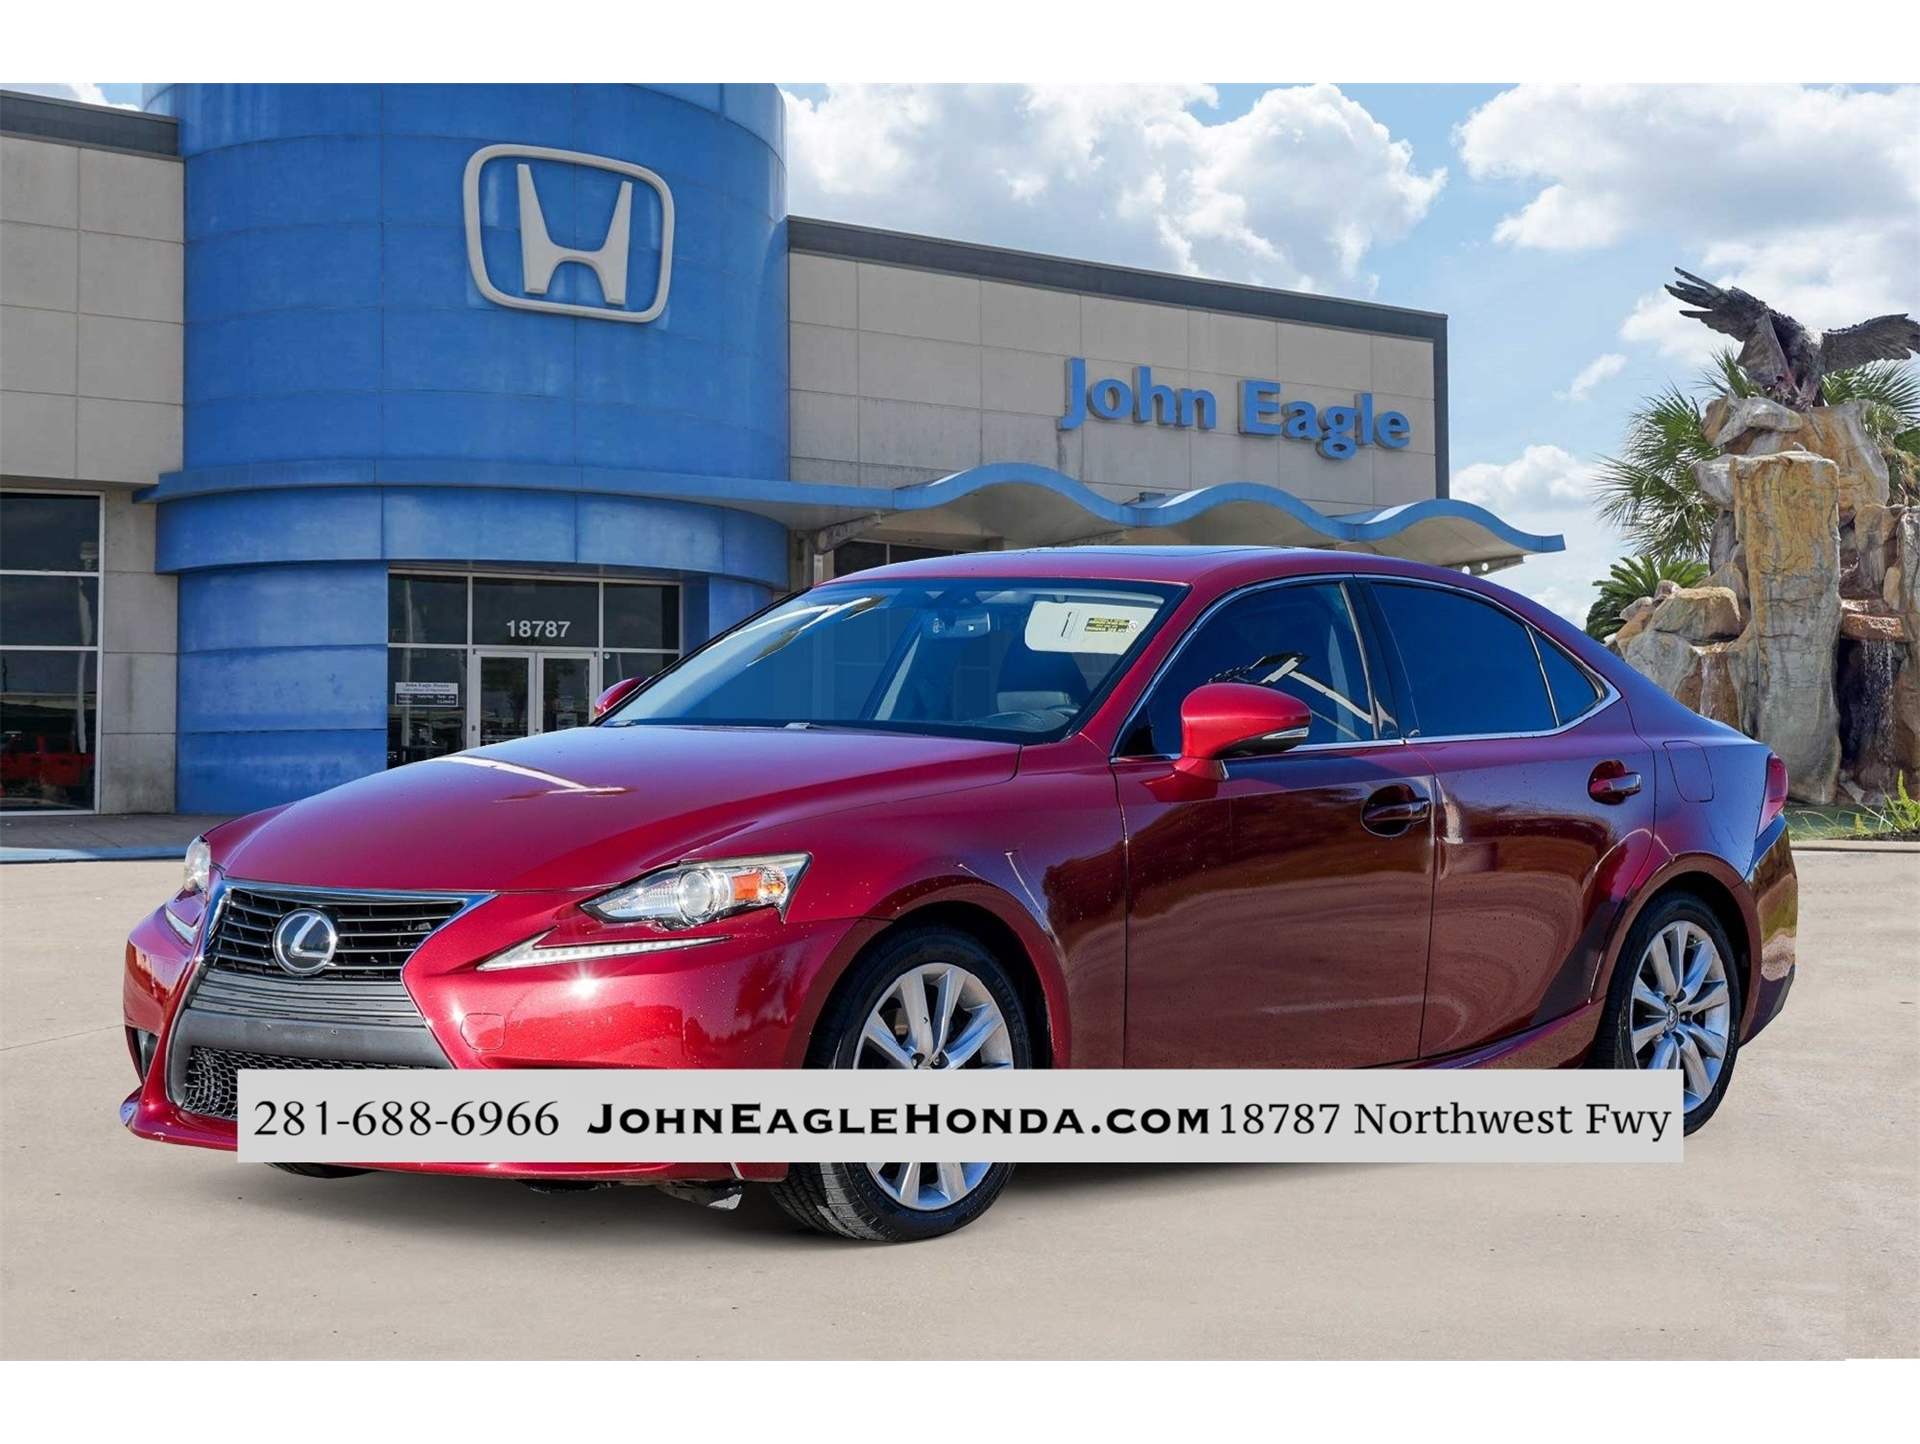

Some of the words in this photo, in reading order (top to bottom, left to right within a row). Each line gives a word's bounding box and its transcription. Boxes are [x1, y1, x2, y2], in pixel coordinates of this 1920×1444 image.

[1057, 357, 1217, 431] John
[1238, 379, 1411, 460] Eagle
[506, 619, 571, 638] 18787
